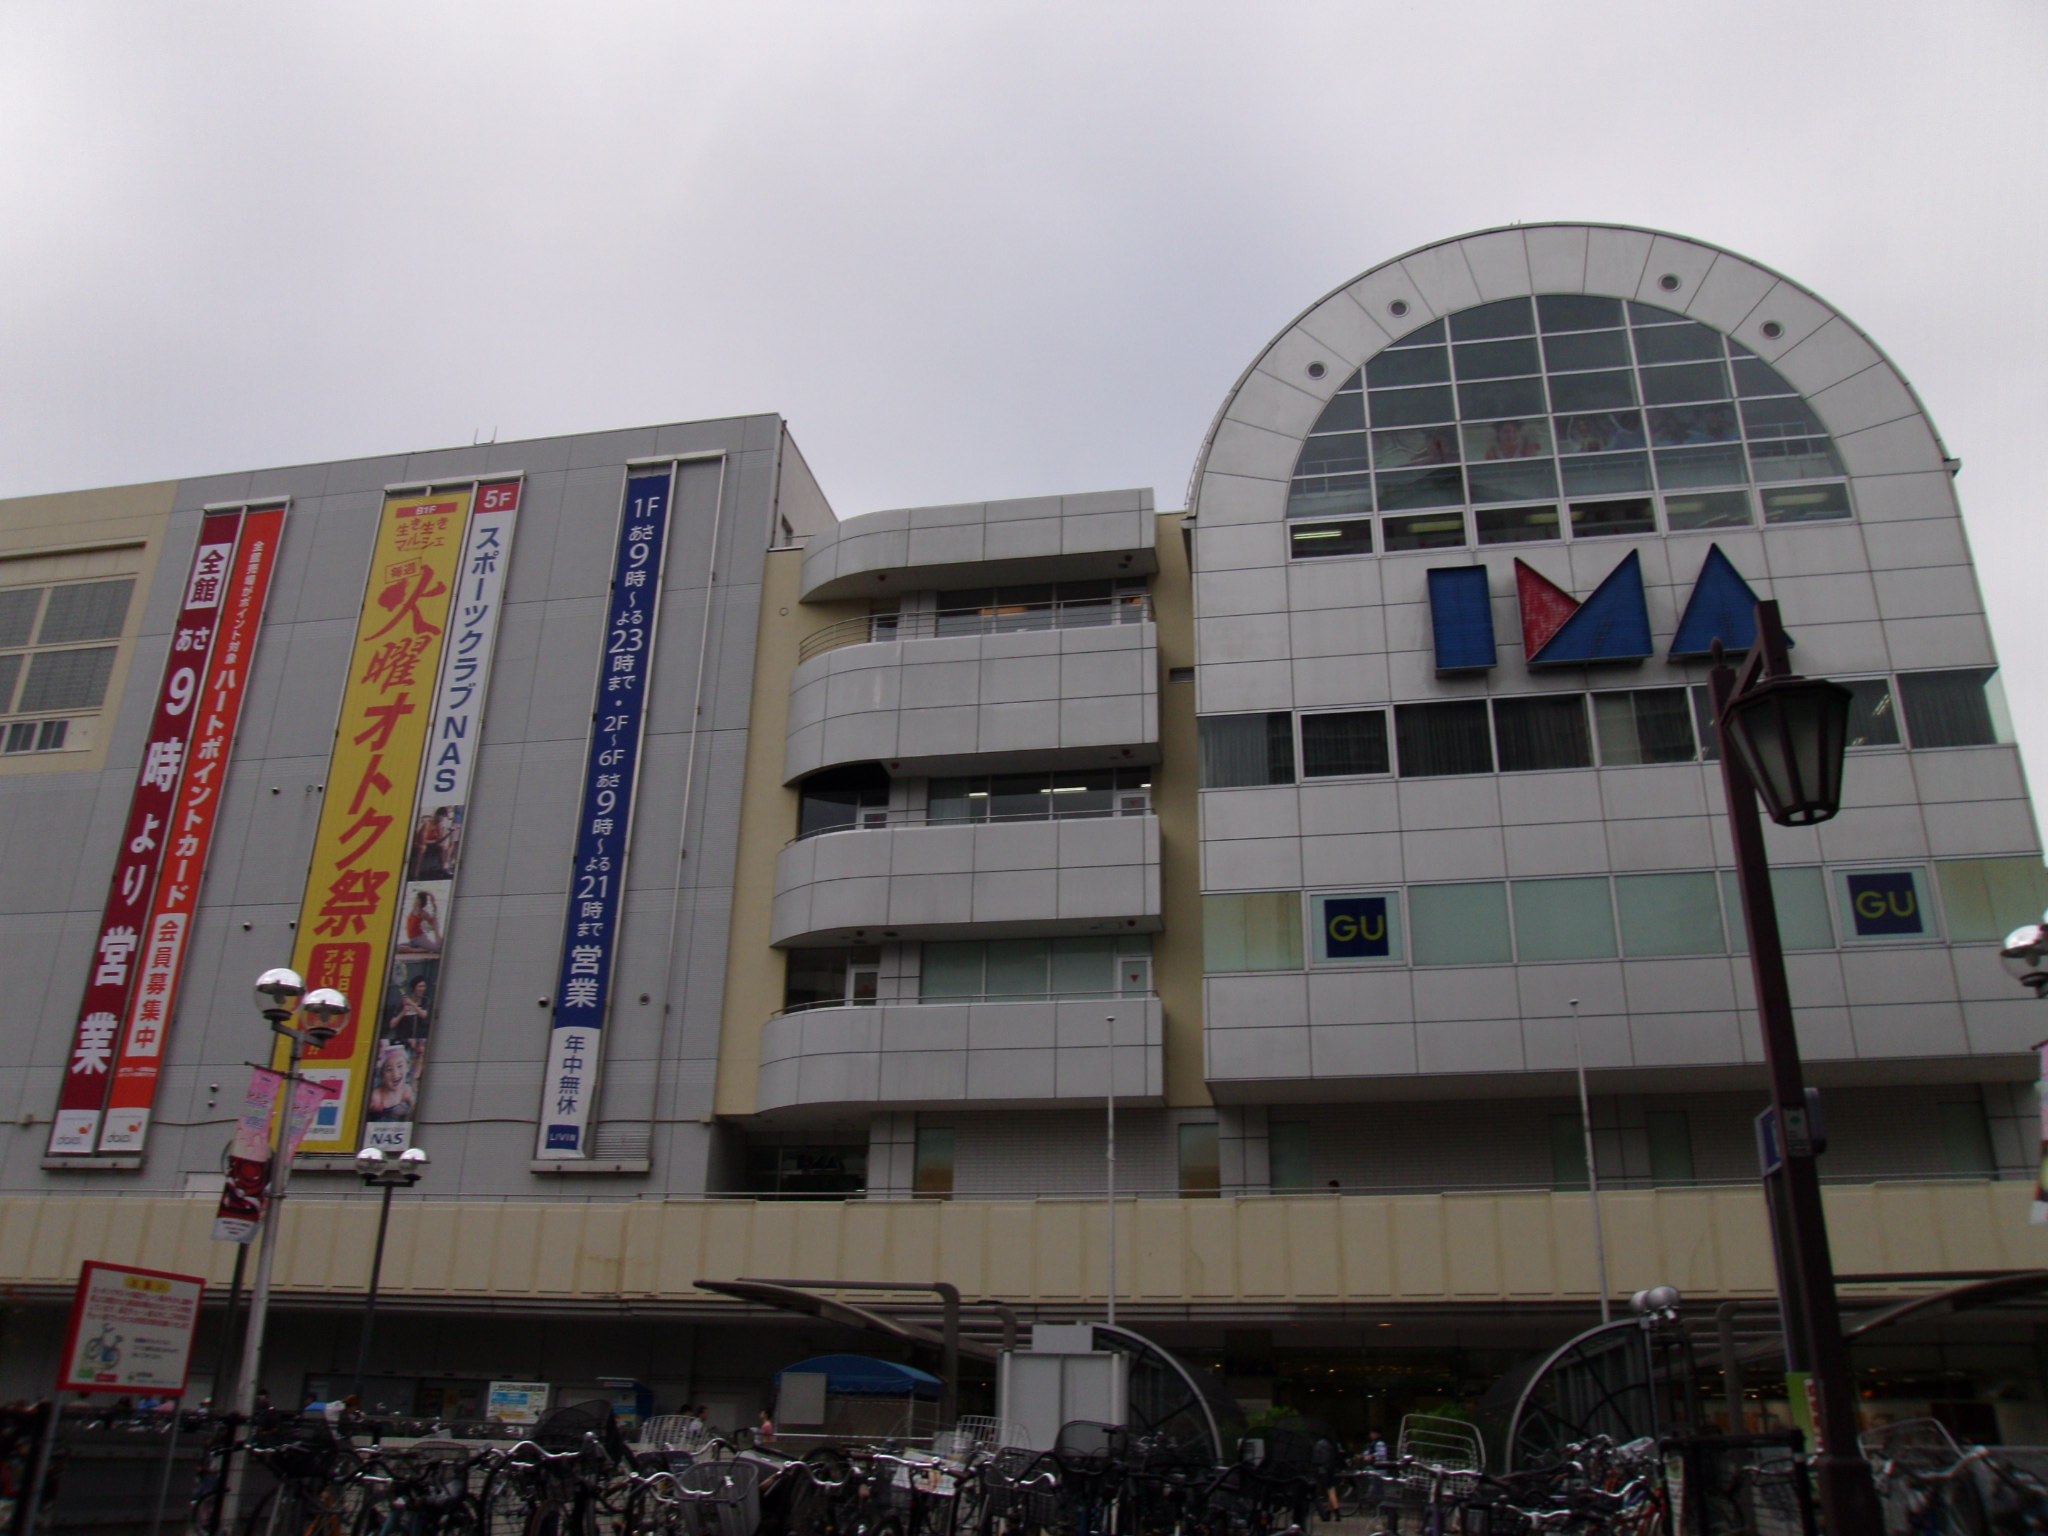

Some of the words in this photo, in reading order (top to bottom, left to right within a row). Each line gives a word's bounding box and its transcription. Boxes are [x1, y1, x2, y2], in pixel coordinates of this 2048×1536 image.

[483, 489, 512, 509] 5F
[190, 549, 224, 603] 全館
[1856, 890, 1915, 918] GU
[1329, 914, 1385, 941] GU
[134, 920, 179, 1048] 会員募集中
[556, 1034, 586, 1116] 年中無休
[370, 1133, 405, 1145] NAS
